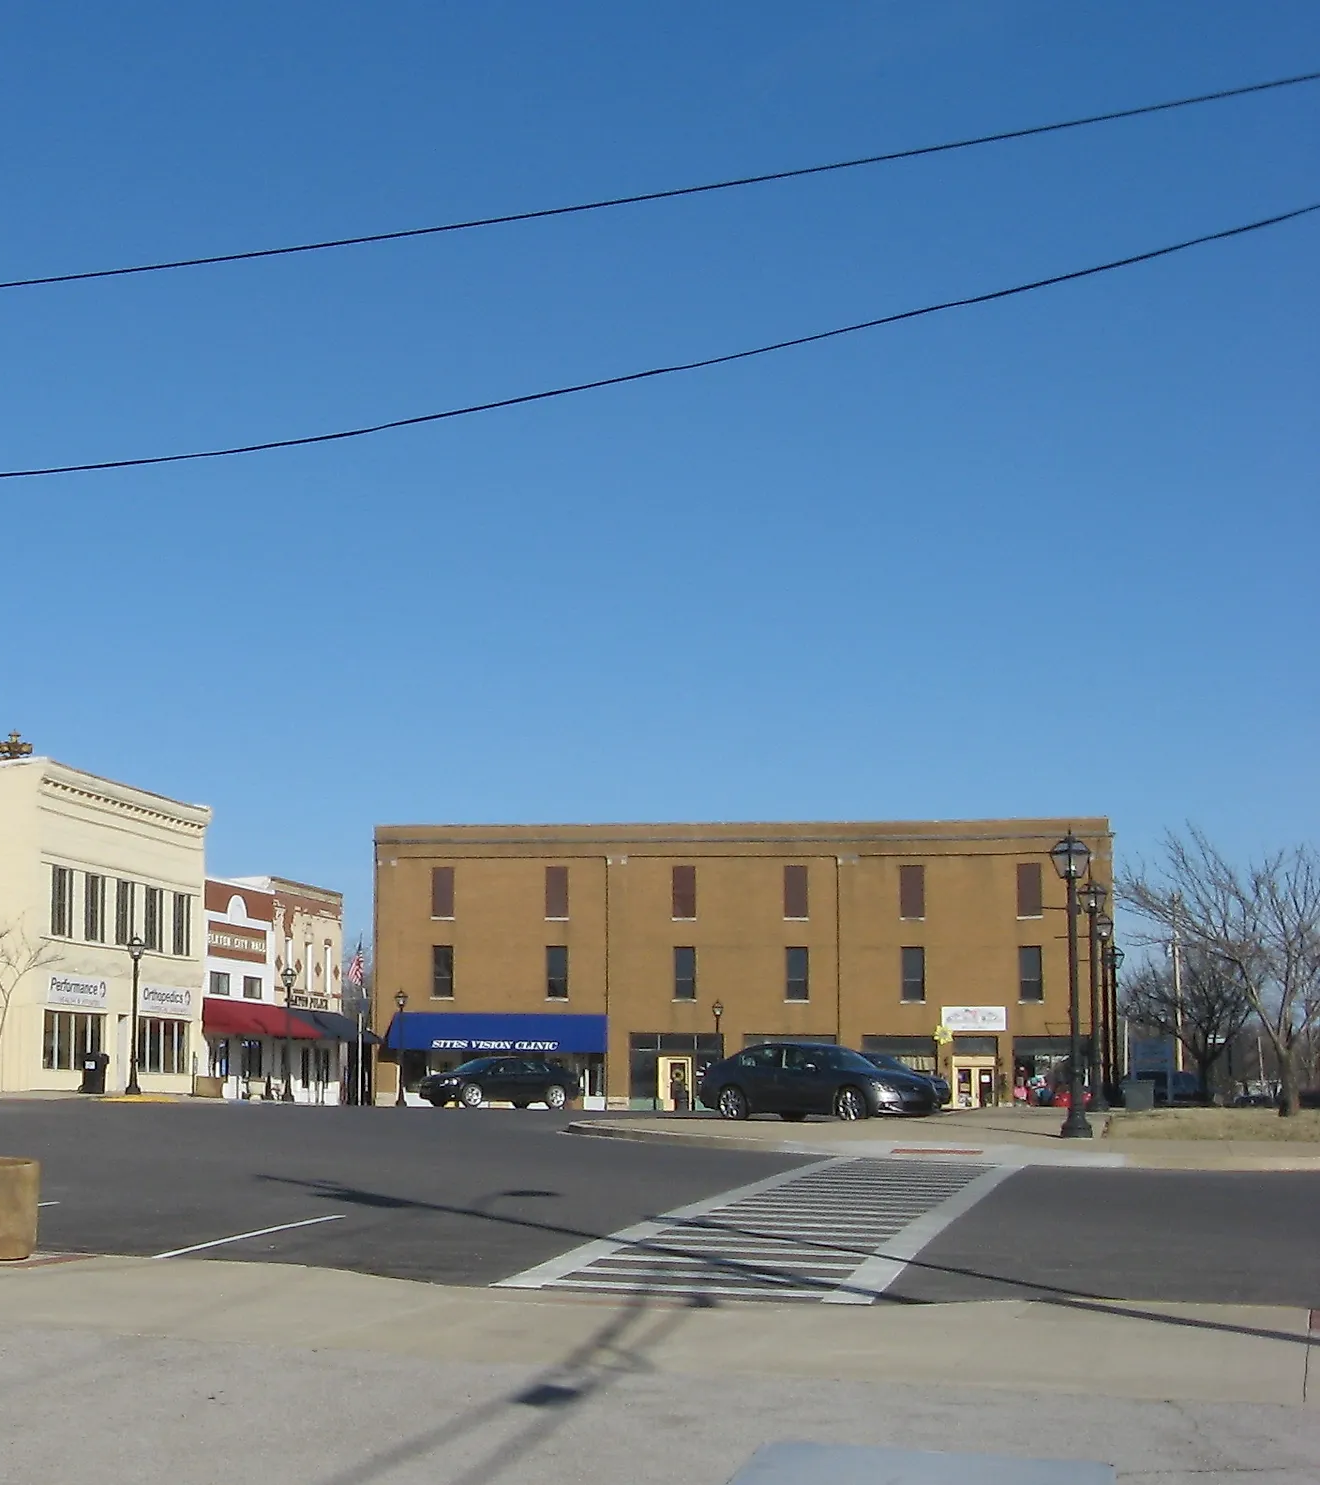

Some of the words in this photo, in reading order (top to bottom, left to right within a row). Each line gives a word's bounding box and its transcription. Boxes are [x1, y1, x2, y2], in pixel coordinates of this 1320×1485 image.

[50, 977, 98, 996] Performance
[143, 987, 184, 1004] Orthopedics
[431, 1039, 469, 1049] SITES
[471, 1040, 513, 1050] VISION
[515, 1041, 559, 1051] CLINIC
